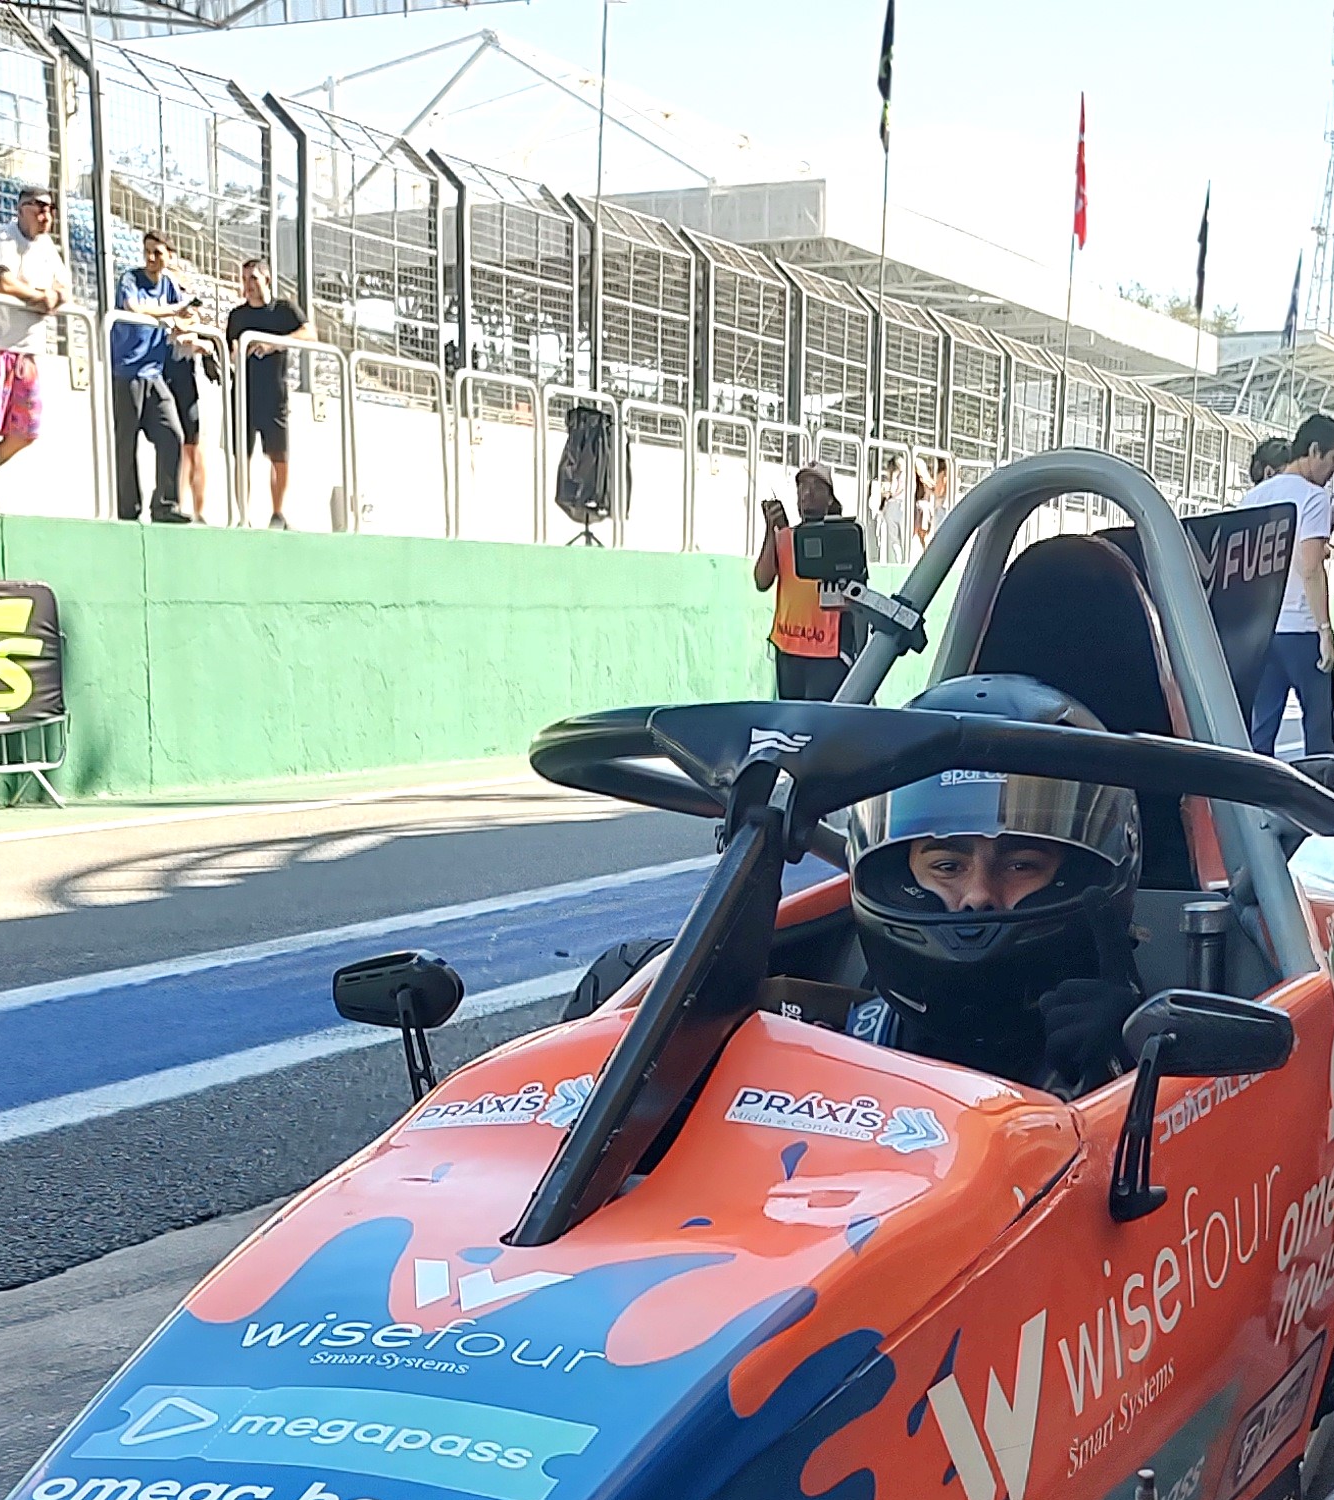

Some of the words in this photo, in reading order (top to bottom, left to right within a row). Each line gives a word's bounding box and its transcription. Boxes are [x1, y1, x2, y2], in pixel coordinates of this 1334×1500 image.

[417, 1092, 542, 1122] PRÁXIS
[735, 1090, 882, 1129] PRÁXIS
[1057, 1164, 1281, 1418] wisefour
[241, 1312, 607, 1373] wisefour
[308, 1350, 381, 1368] Smart
[382, 1350, 470, 1376] Systems
[227, 1412, 535, 1472] megapass
[1067, 1416, 1115, 1478] Smart
[1117, 1356, 1177, 1434] Systems
